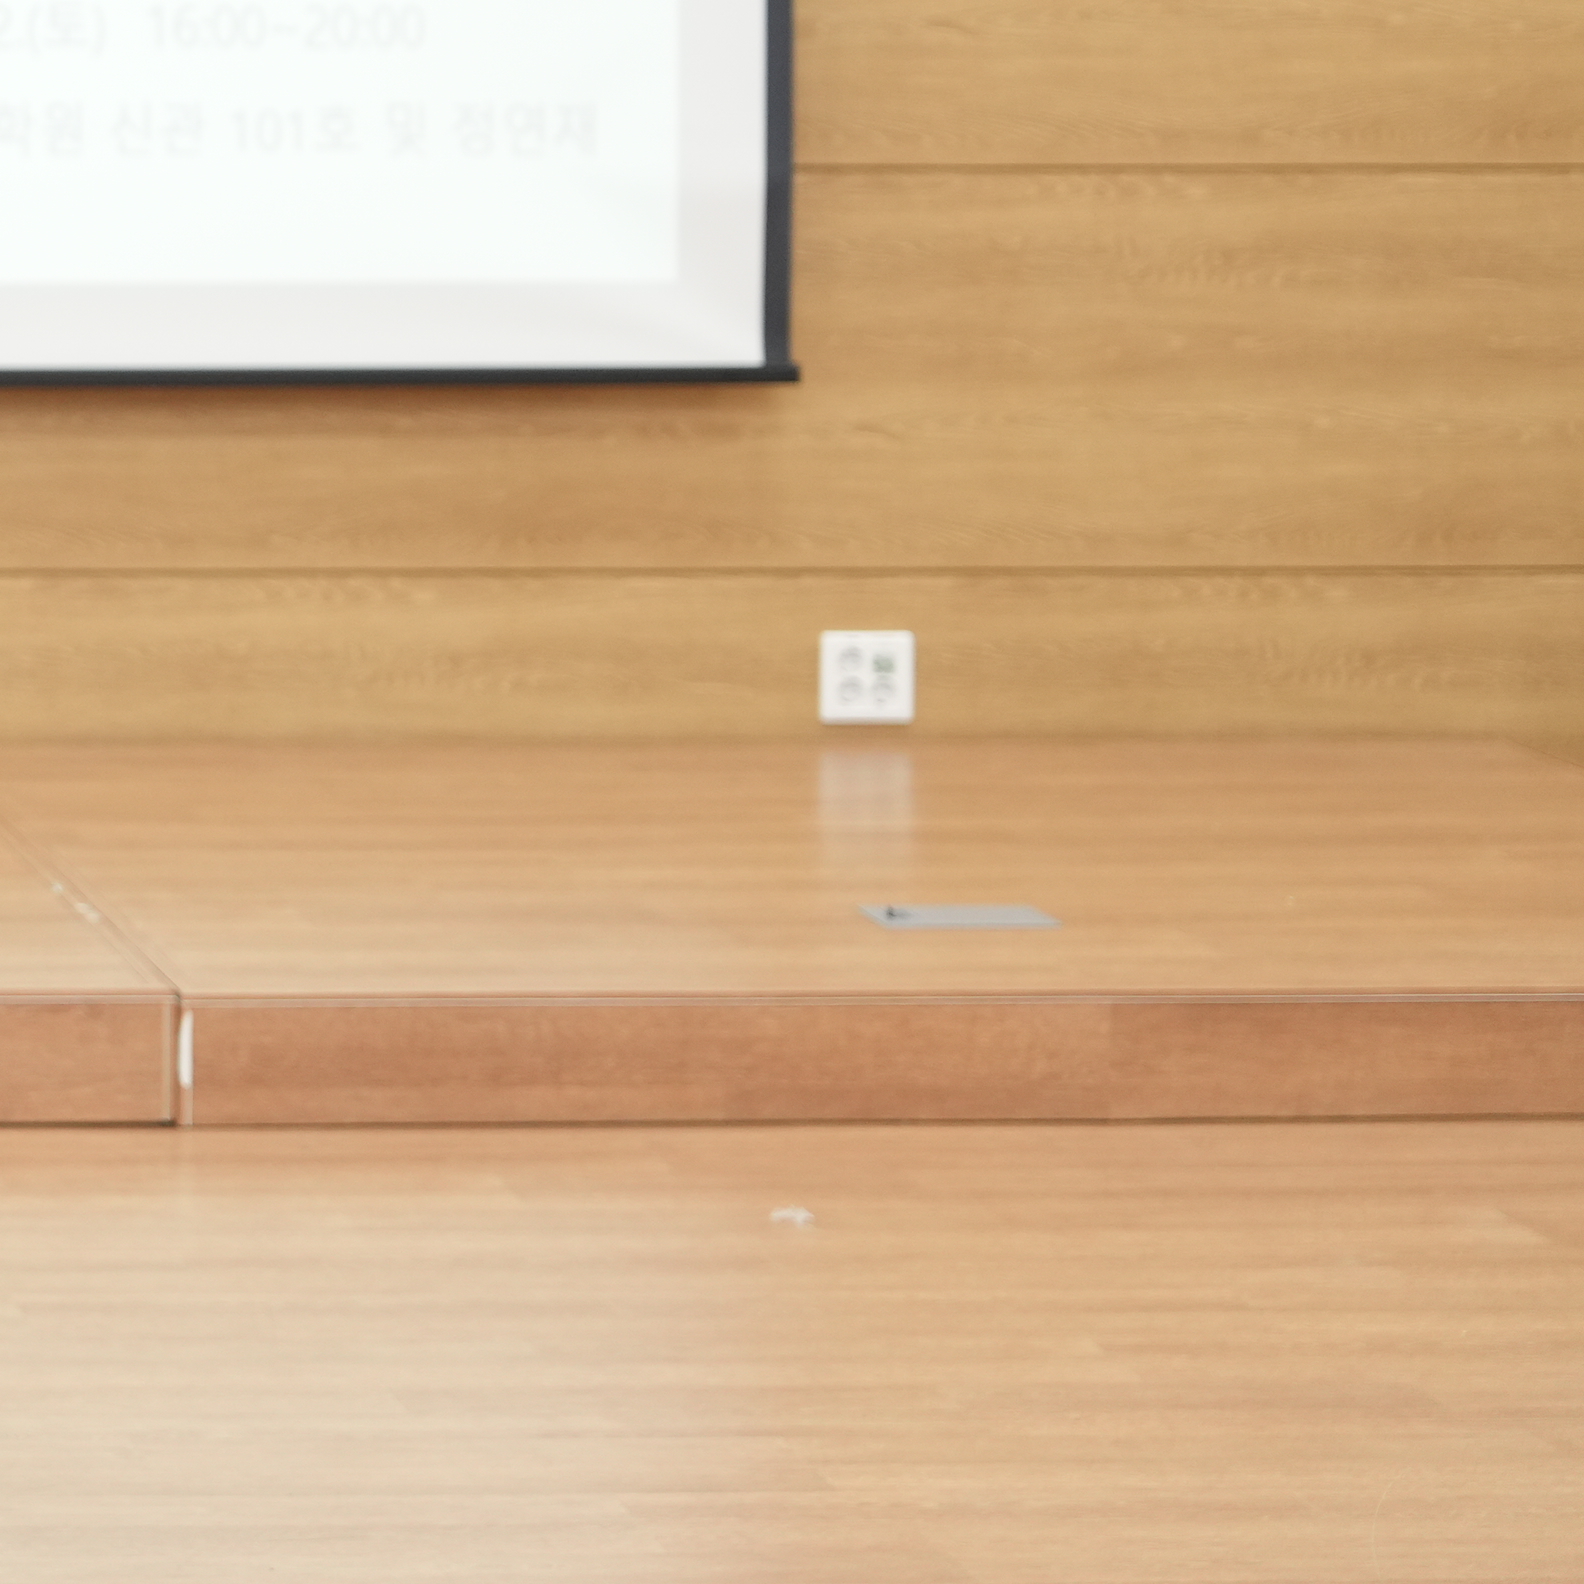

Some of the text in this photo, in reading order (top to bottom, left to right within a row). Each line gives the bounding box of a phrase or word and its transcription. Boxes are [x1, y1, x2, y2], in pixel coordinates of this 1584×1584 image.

[111, 98, 208, 160] 신관
[230, 100, 362, 159] 101호
[385, 99, 429, 160] 및
